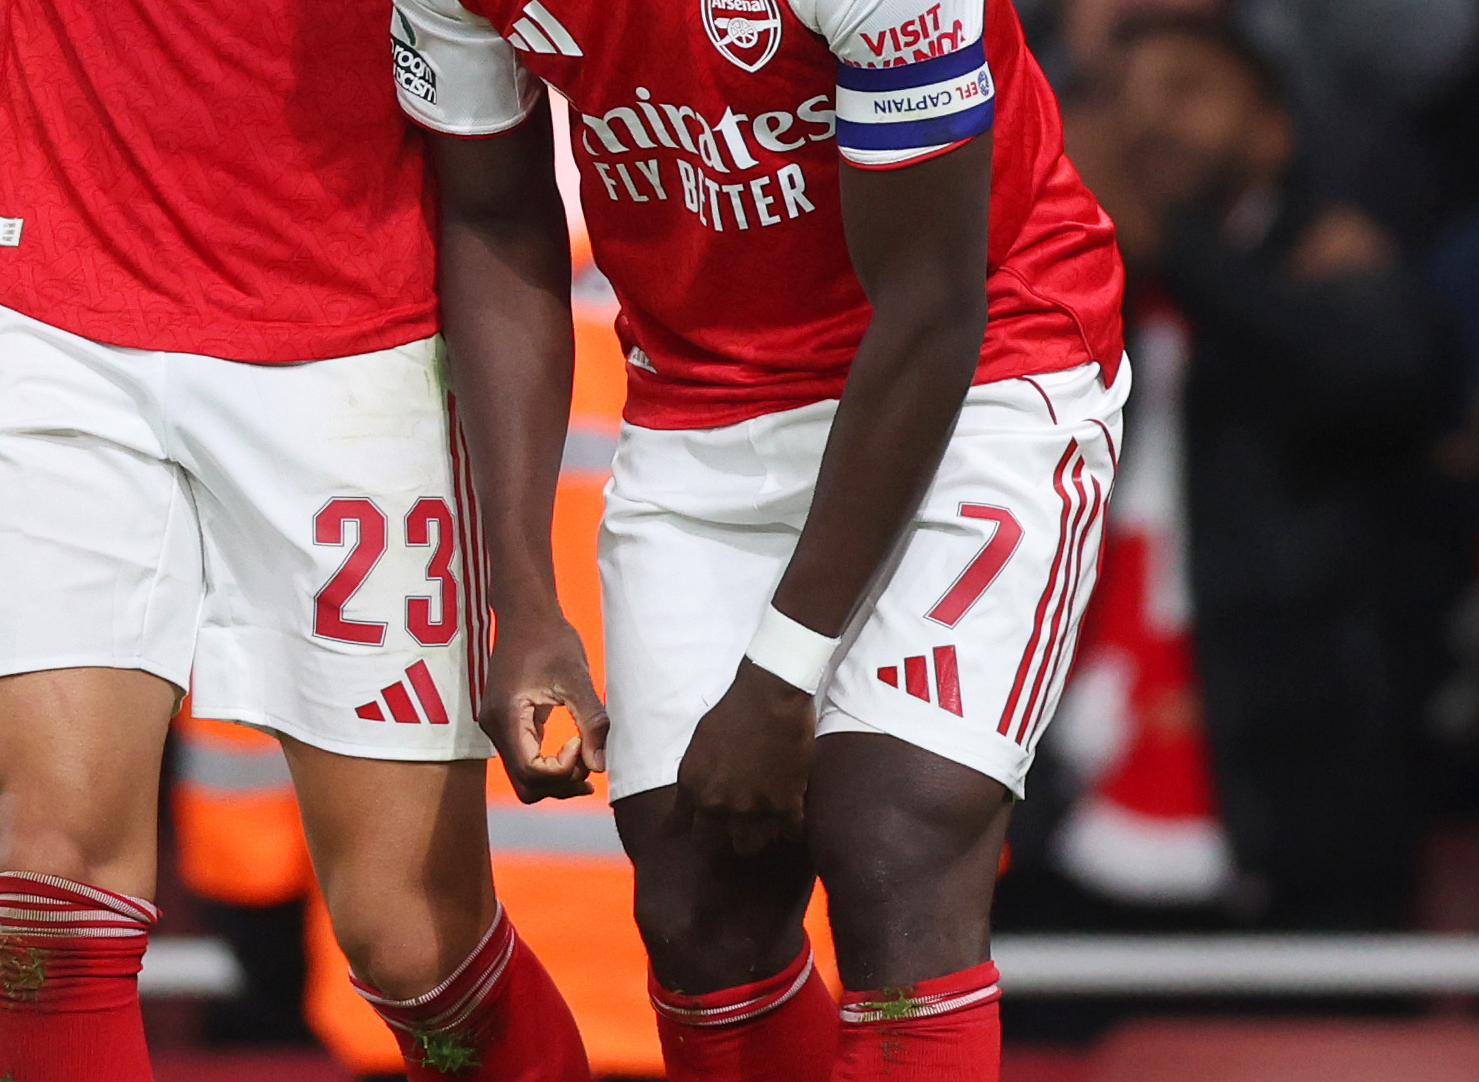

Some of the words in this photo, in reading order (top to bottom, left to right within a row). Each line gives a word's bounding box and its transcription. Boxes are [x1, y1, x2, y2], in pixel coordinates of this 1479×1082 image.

[859, 2, 941, 57] VISIT
[874, 91, 952, 114] CAPTAIN
[955, 81, 979, 100] EFL
[582, 86, 836, 173] mirates
[593, 158, 668, 202] FLY
[677, 158, 816, 232] BETTER
[312, 495, 459, 648] 23
[923, 501, 1025, 628] 7
